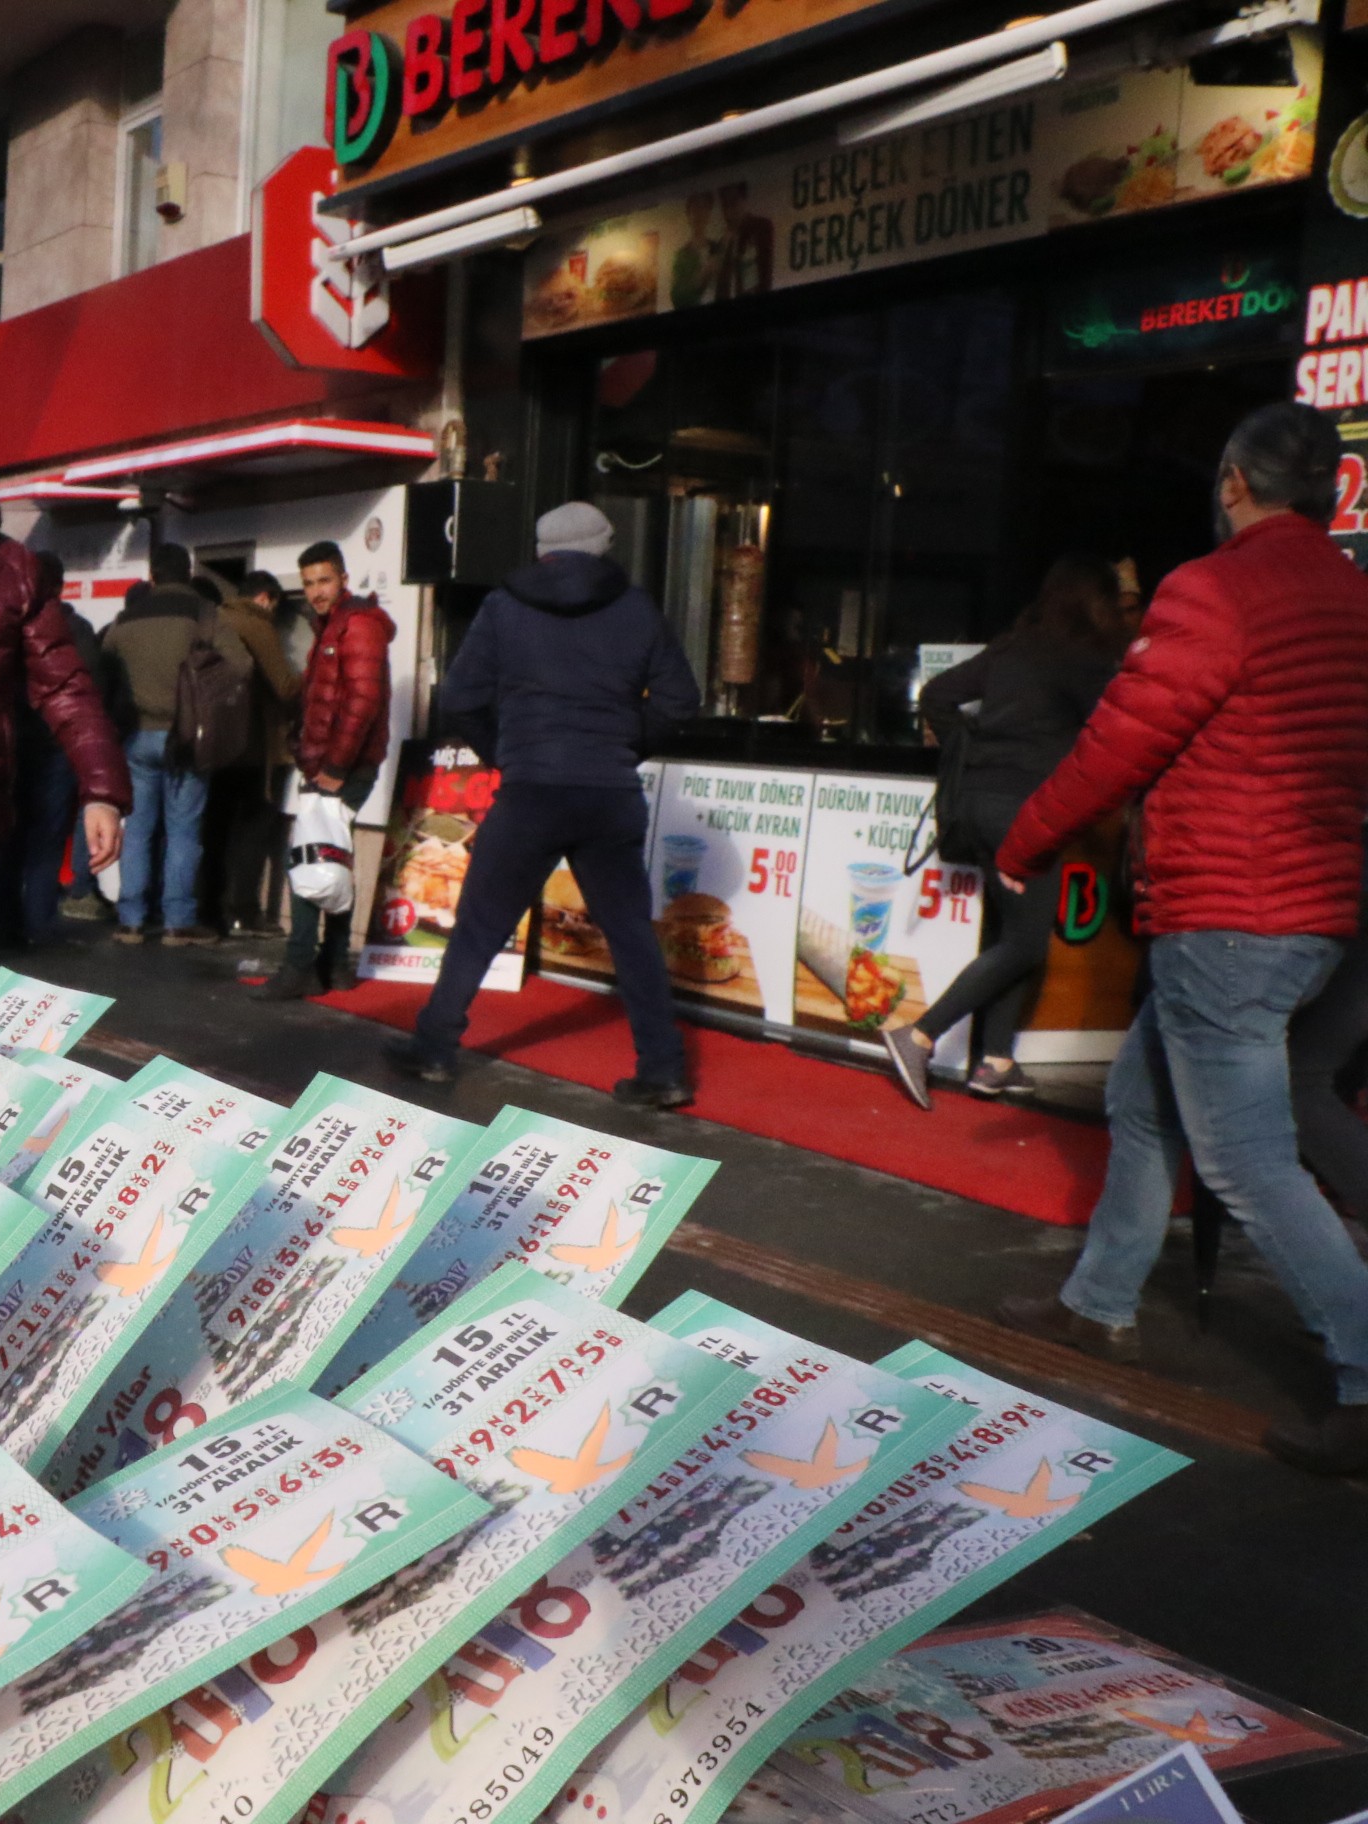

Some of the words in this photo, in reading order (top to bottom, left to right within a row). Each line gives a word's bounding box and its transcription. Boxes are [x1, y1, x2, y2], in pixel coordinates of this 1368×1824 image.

[789, 201, 906, 271] GERÇEK
[914, 169, 1030, 245] DÖNER
[683, 772, 712, 798] PİDE
[715, 780, 756, 801] TAVUK
[759, 781, 806, 806] DÖNER
[818, 786, 871, 813] DÜRÜM
[707, 809, 751, 835] KÜÇÜK
[754, 812, 801, 838] AYRAN
[272, 1135, 312, 1175] 15
[315, 1115, 333, 1130] TL
[280, 1192, 302, 1213] 31
[302, 1122, 358, 1188] ARALIK
[468, 1161, 510, 1196] 15
[512, 1144, 531, 1159] TL
[44, 1157, 86, 1201] 15
[74, 1146, 131, 1217] ARALIK
[486, 1210, 510, 1231] 31
[508, 1150, 559, 1209] ARALIK
[213, 1245, 254, 1295] 2017
[432, 1325, 494, 1368] 15
[501, 1310, 528, 1327] TL
[443, 1360, 486, 1394] DÖRTTE
[486, 1343, 506, 1361] BİR
[505, 1318, 540, 1346] BİLET
[441, 1392, 474, 1417] 31
[475, 1325, 559, 1392] ARALIK
[178, 1436, 244, 1472] 15
[252, 1421, 281, 1438] TL
[855, 1409, 901, 1434] R
[173, 1492, 206, 1515] 31
[212, 1435, 304, 1494] ARALIK
[178, 1463, 228, 1497] DÖRTTE
[228, 1448, 253, 1467] BİR
[252, 1428, 289, 1452] BİLET
[1069, 1451, 1113, 1474] R
